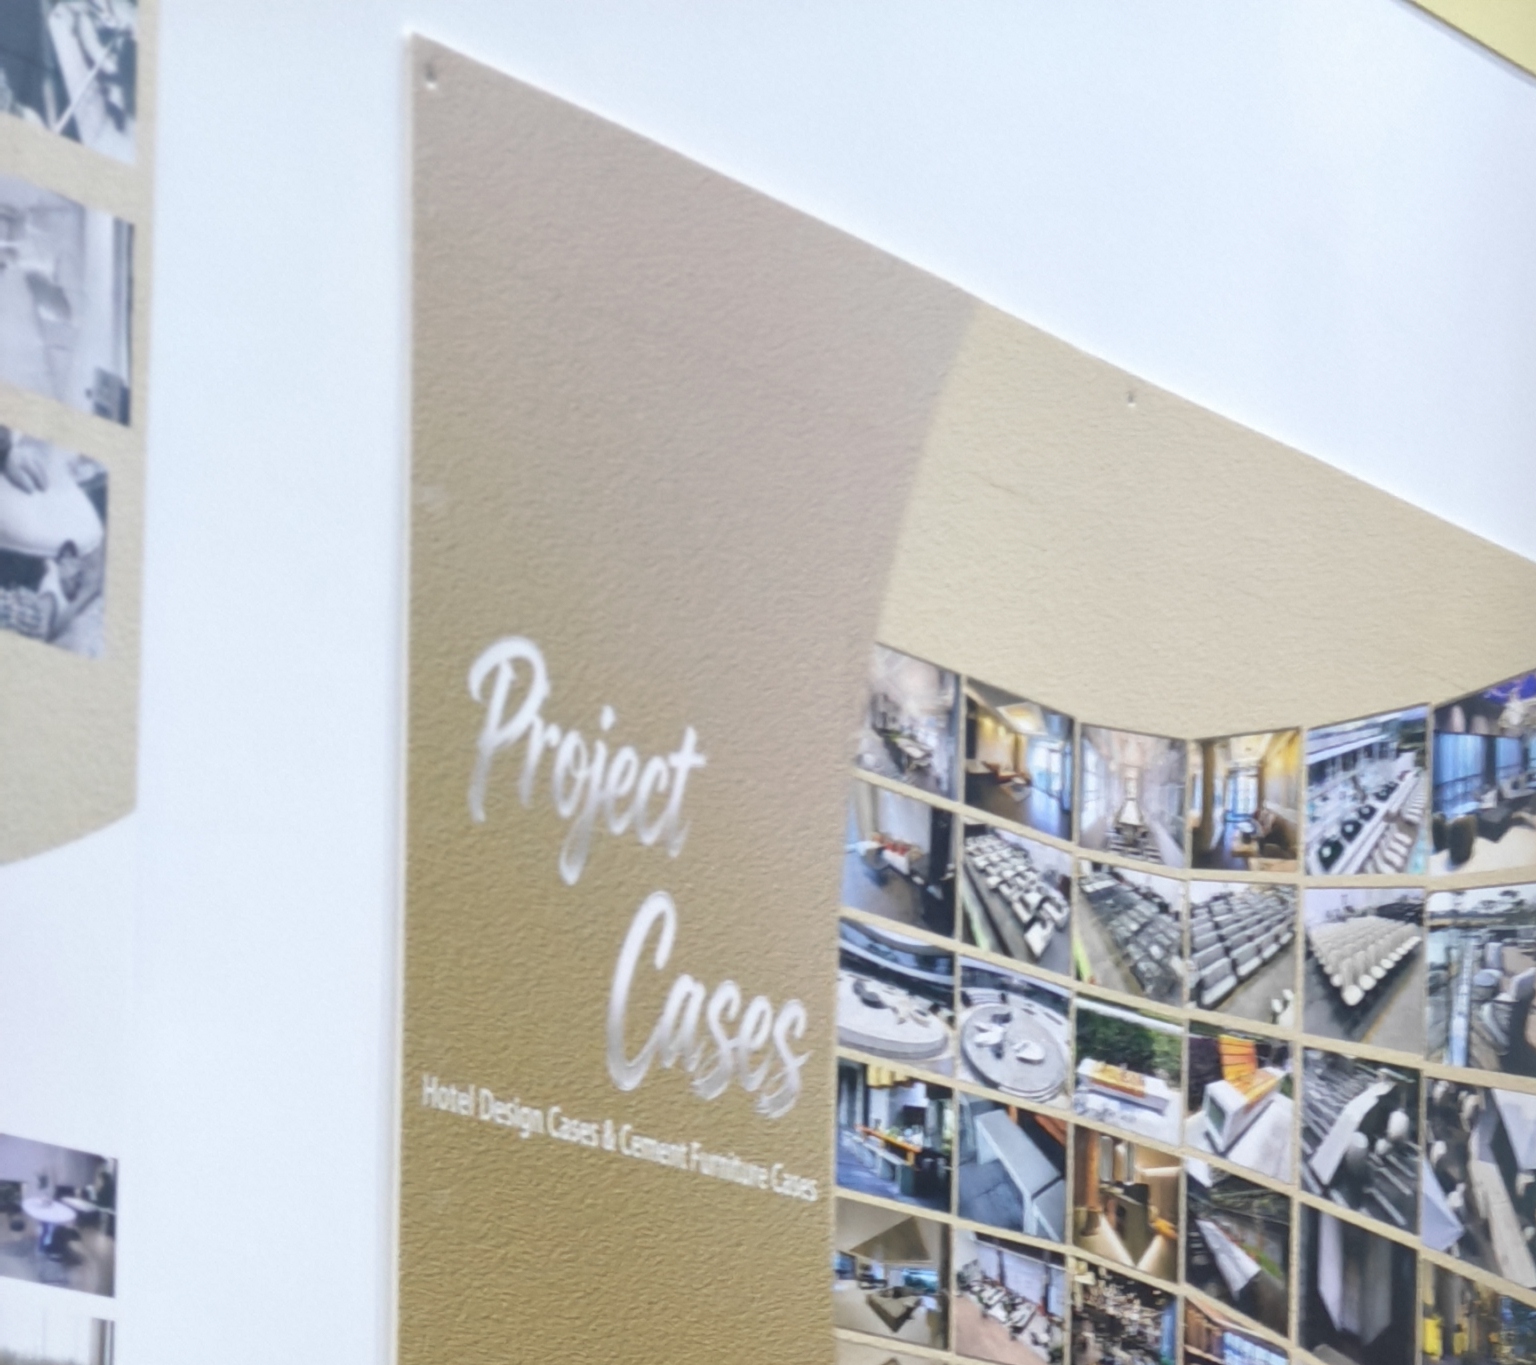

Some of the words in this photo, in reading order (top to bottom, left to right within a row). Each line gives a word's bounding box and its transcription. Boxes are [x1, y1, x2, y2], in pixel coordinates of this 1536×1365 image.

[468, 635, 706, 886] Project
[606, 890, 810, 1120] Cases
[421, 1073, 475, 1117] Hotel
[478, 1087, 545, 1139] Design
[547, 1105, 600, 1147] Cases
[601, 1118, 616, 1151] &
[618, 1123, 688, 1171] Cement
[689, 1141, 769, 1190] Furniture
[770, 1162, 818, 1202] Cases
